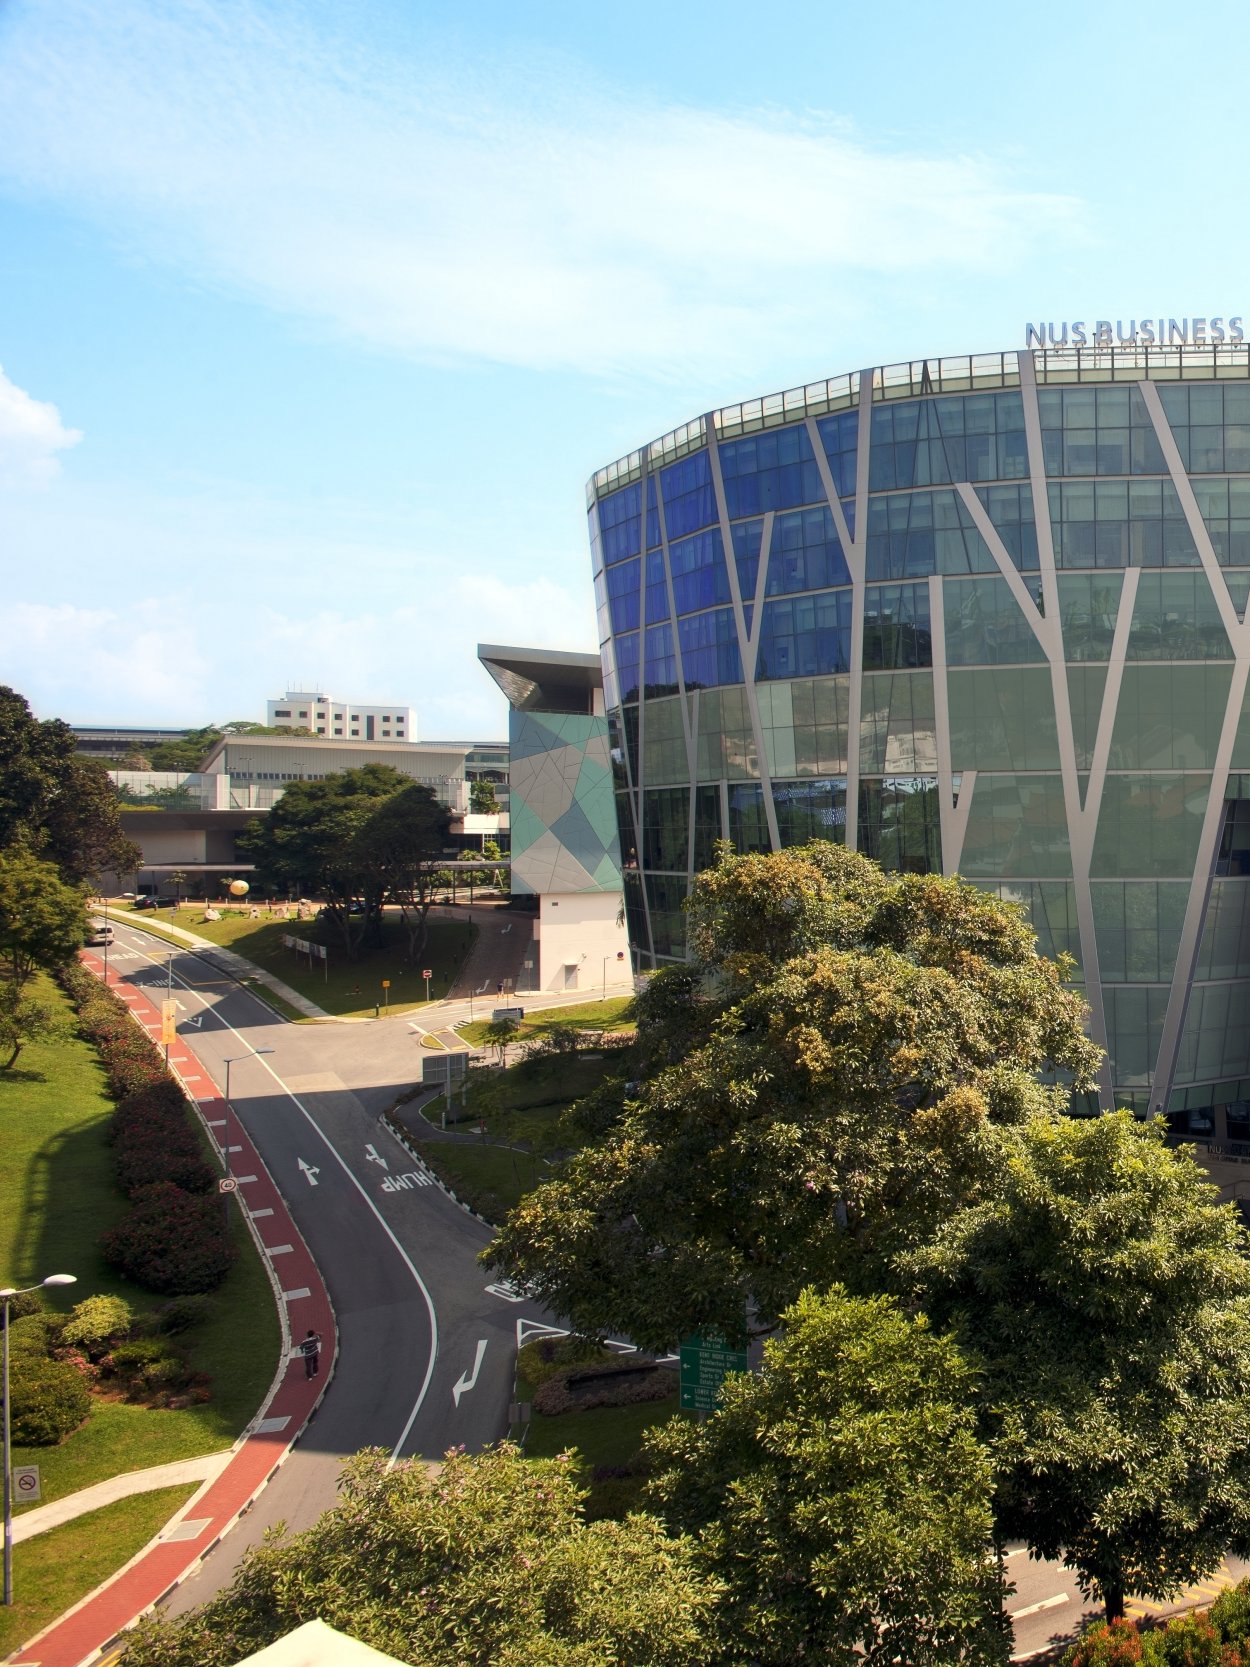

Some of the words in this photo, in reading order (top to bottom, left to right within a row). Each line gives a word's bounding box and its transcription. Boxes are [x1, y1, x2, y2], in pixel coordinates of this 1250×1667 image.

[1025, 321, 1087, 346] NUS
[1096, 317, 1244, 345] BUSINESS
[381, 1171, 433, 1192] HUMP
